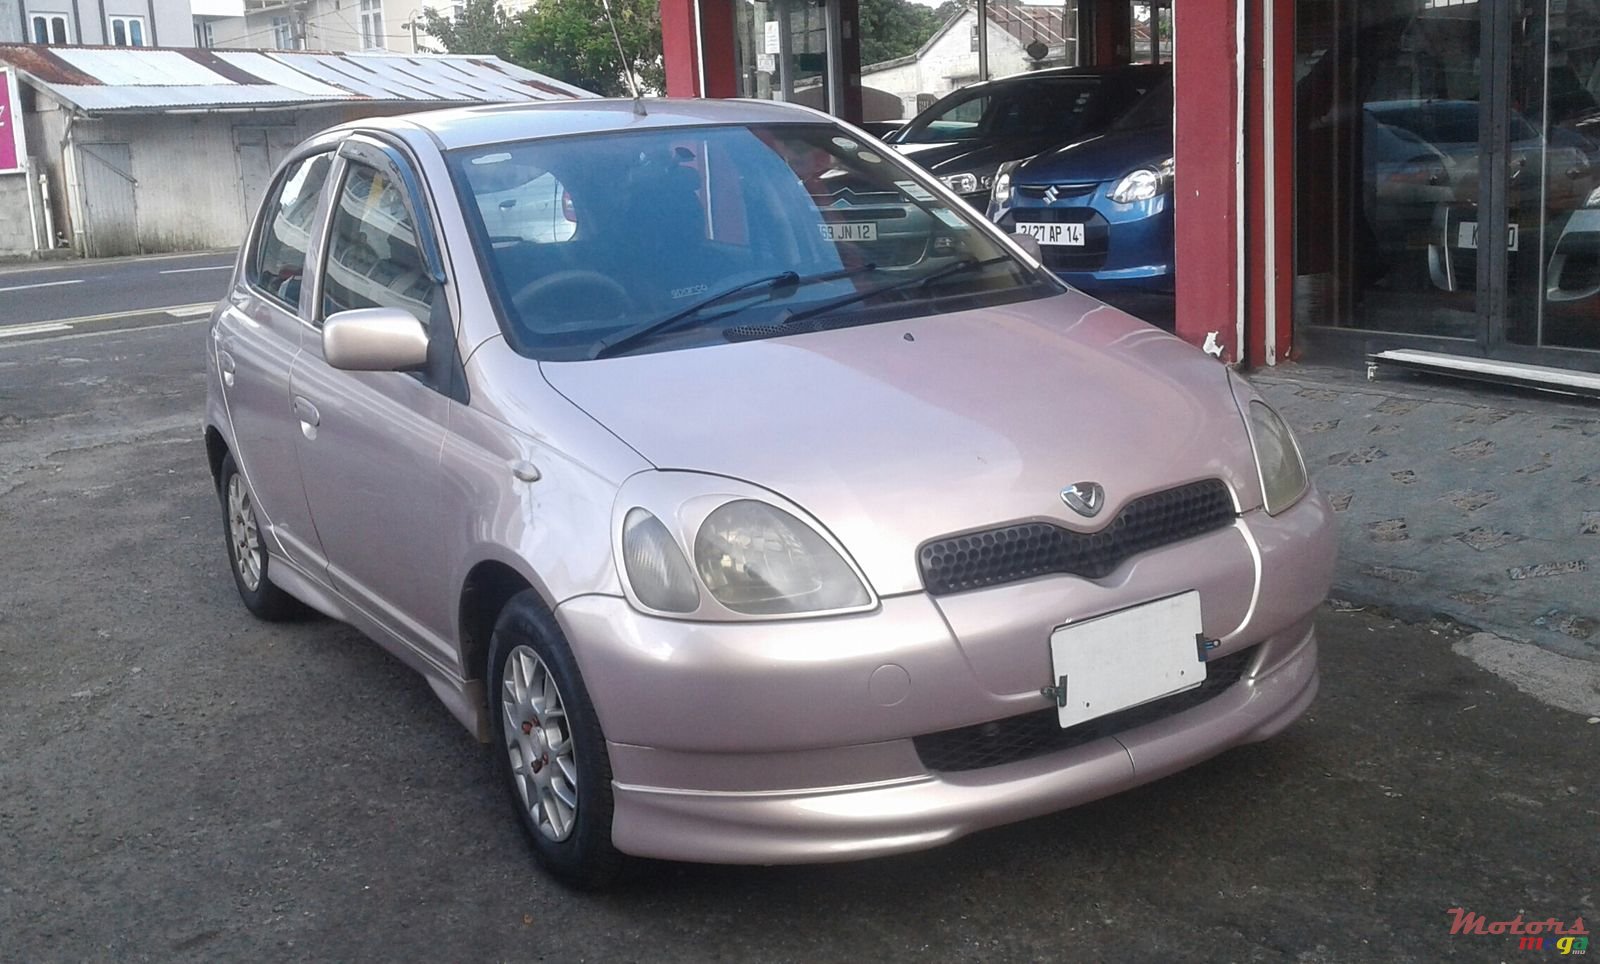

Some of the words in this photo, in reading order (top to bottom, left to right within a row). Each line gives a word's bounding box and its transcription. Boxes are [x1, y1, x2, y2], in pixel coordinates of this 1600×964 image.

[838, 225, 852, 239] JN
[857, 225, 871, 239] 12
[1049, 225, 1062, 242] AP
[1067, 225, 1079, 242] 14
